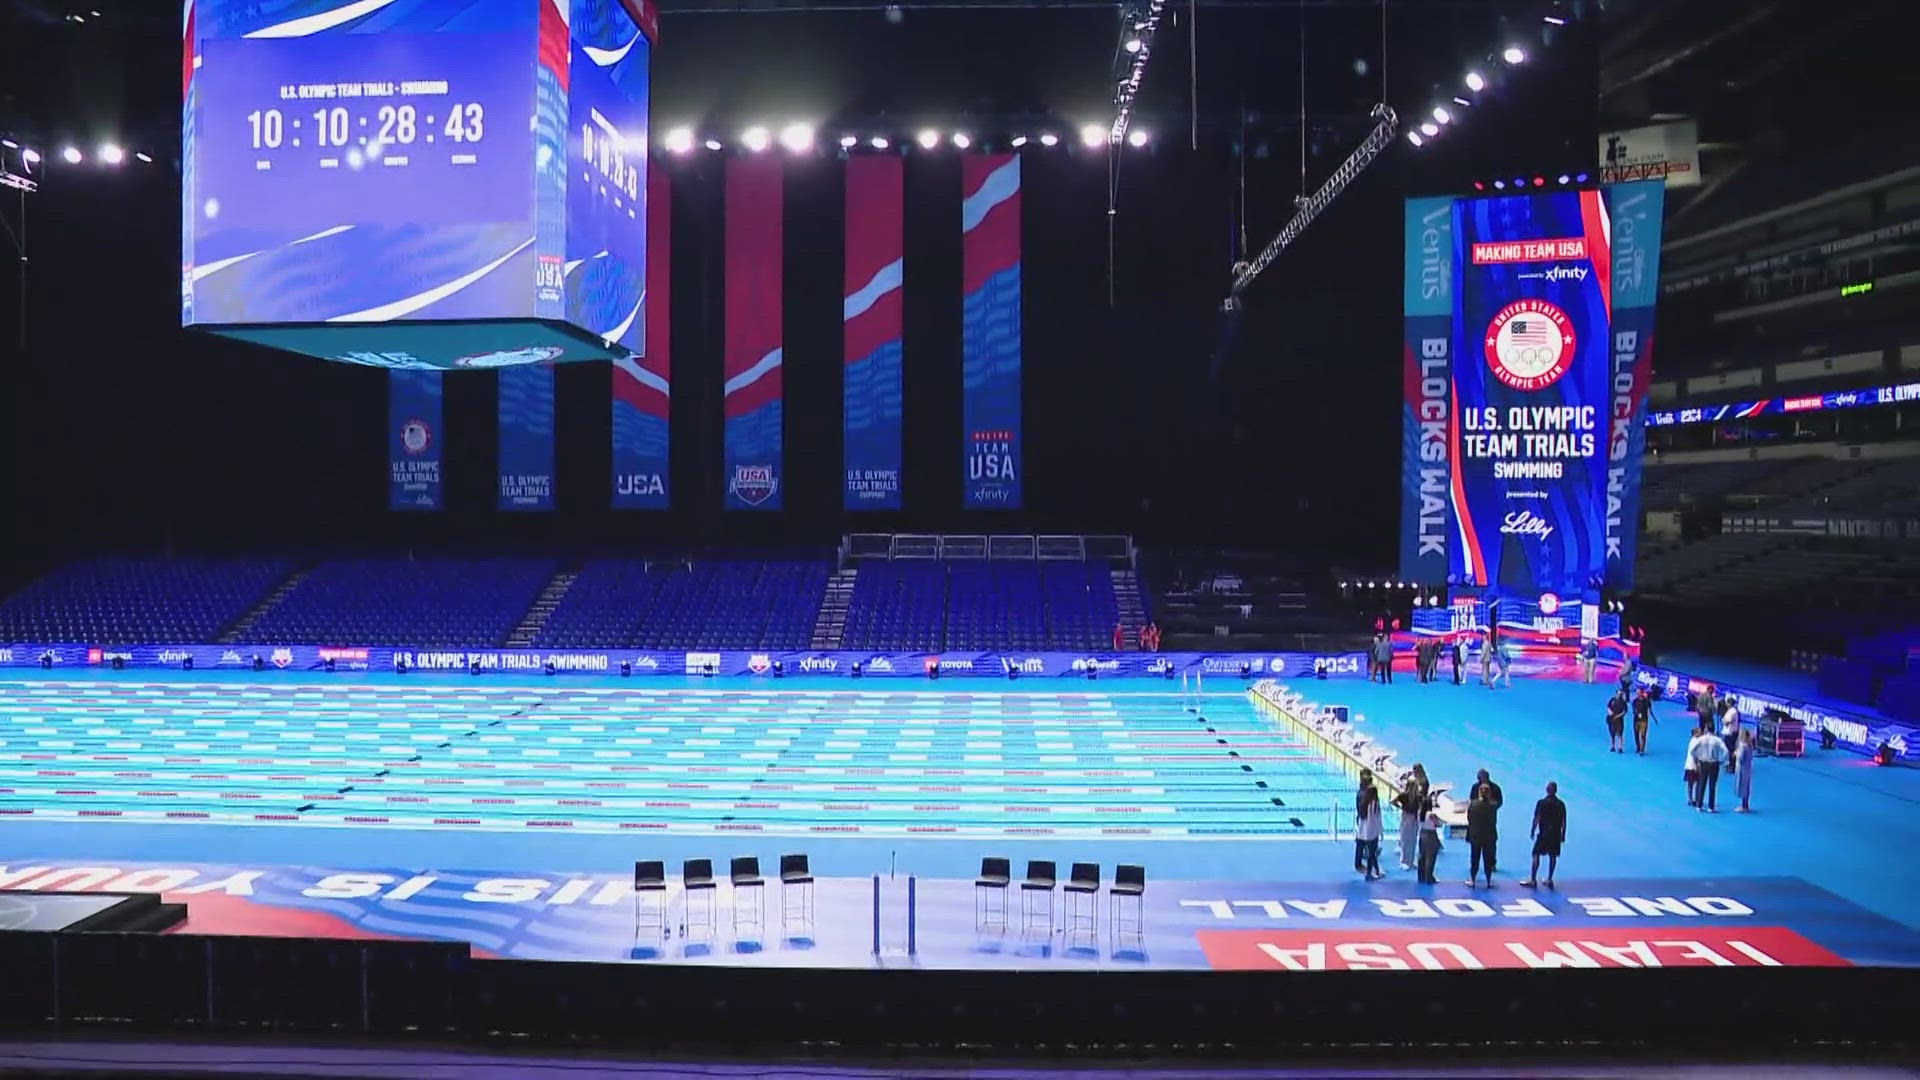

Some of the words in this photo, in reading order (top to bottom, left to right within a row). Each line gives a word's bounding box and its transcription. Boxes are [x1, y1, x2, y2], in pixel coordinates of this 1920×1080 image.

[337, 82, 363, 97] TEAM
[247, 109, 283, 149] 10
[313, 106, 350, 147] 10
[378, 105, 416, 145] 28
[444, 102, 484, 143] 43
[1475, 245, 1521, 262] MAKING
[1523, 242, 1555, 260] TEAM
[1558, 240, 1585, 258] USA
[1545, 265, 1589, 283] xfinity
[1531, 302, 1565, 325] STATES
[1538, 364, 1563, 386] TEAM
[1420, 337, 1448, 463] BLOCKS
[1609, 330, 1638, 462] BLOCKS
[1465, 406, 1502, 431] U.S.
[1508, 405, 1595, 431] OLYMPIC
[974, 443, 1009, 454] TEAM
[1464, 433, 1518, 458] TEAM
[1523, 433, 1595, 458] TRIALS
[740, 469, 767, 481] USA
[847, 470, 862, 481] U.S.
[864, 469, 898, 481] OLYMPIC
[969, 454, 1015, 481] USA
[1494, 461, 1563, 479] SWIMMING
[617, 474, 665, 495] USA
[848, 481, 869, 491] TEAM
[870, 481, 898, 491] TRIALS
[974, 486, 1010, 502] xfinity
[1418, 469, 1446, 557] WALK
[1605, 467, 1624, 561] WALK
[1499, 509, 1554, 542] Lilly
[417, 653, 464, 669] OLYMPIC
[501, 654, 541, 669] TRIALS
[800, 657, 838, 672] xfinity
[941, 661, 973, 669] TOYOTA
[1179, 899, 1350, 919] ALL
[1368, 897, 1556, 919] FOR
[1567, 896, 1755, 917] ONE
[1257, 942, 1487, 970] USA
